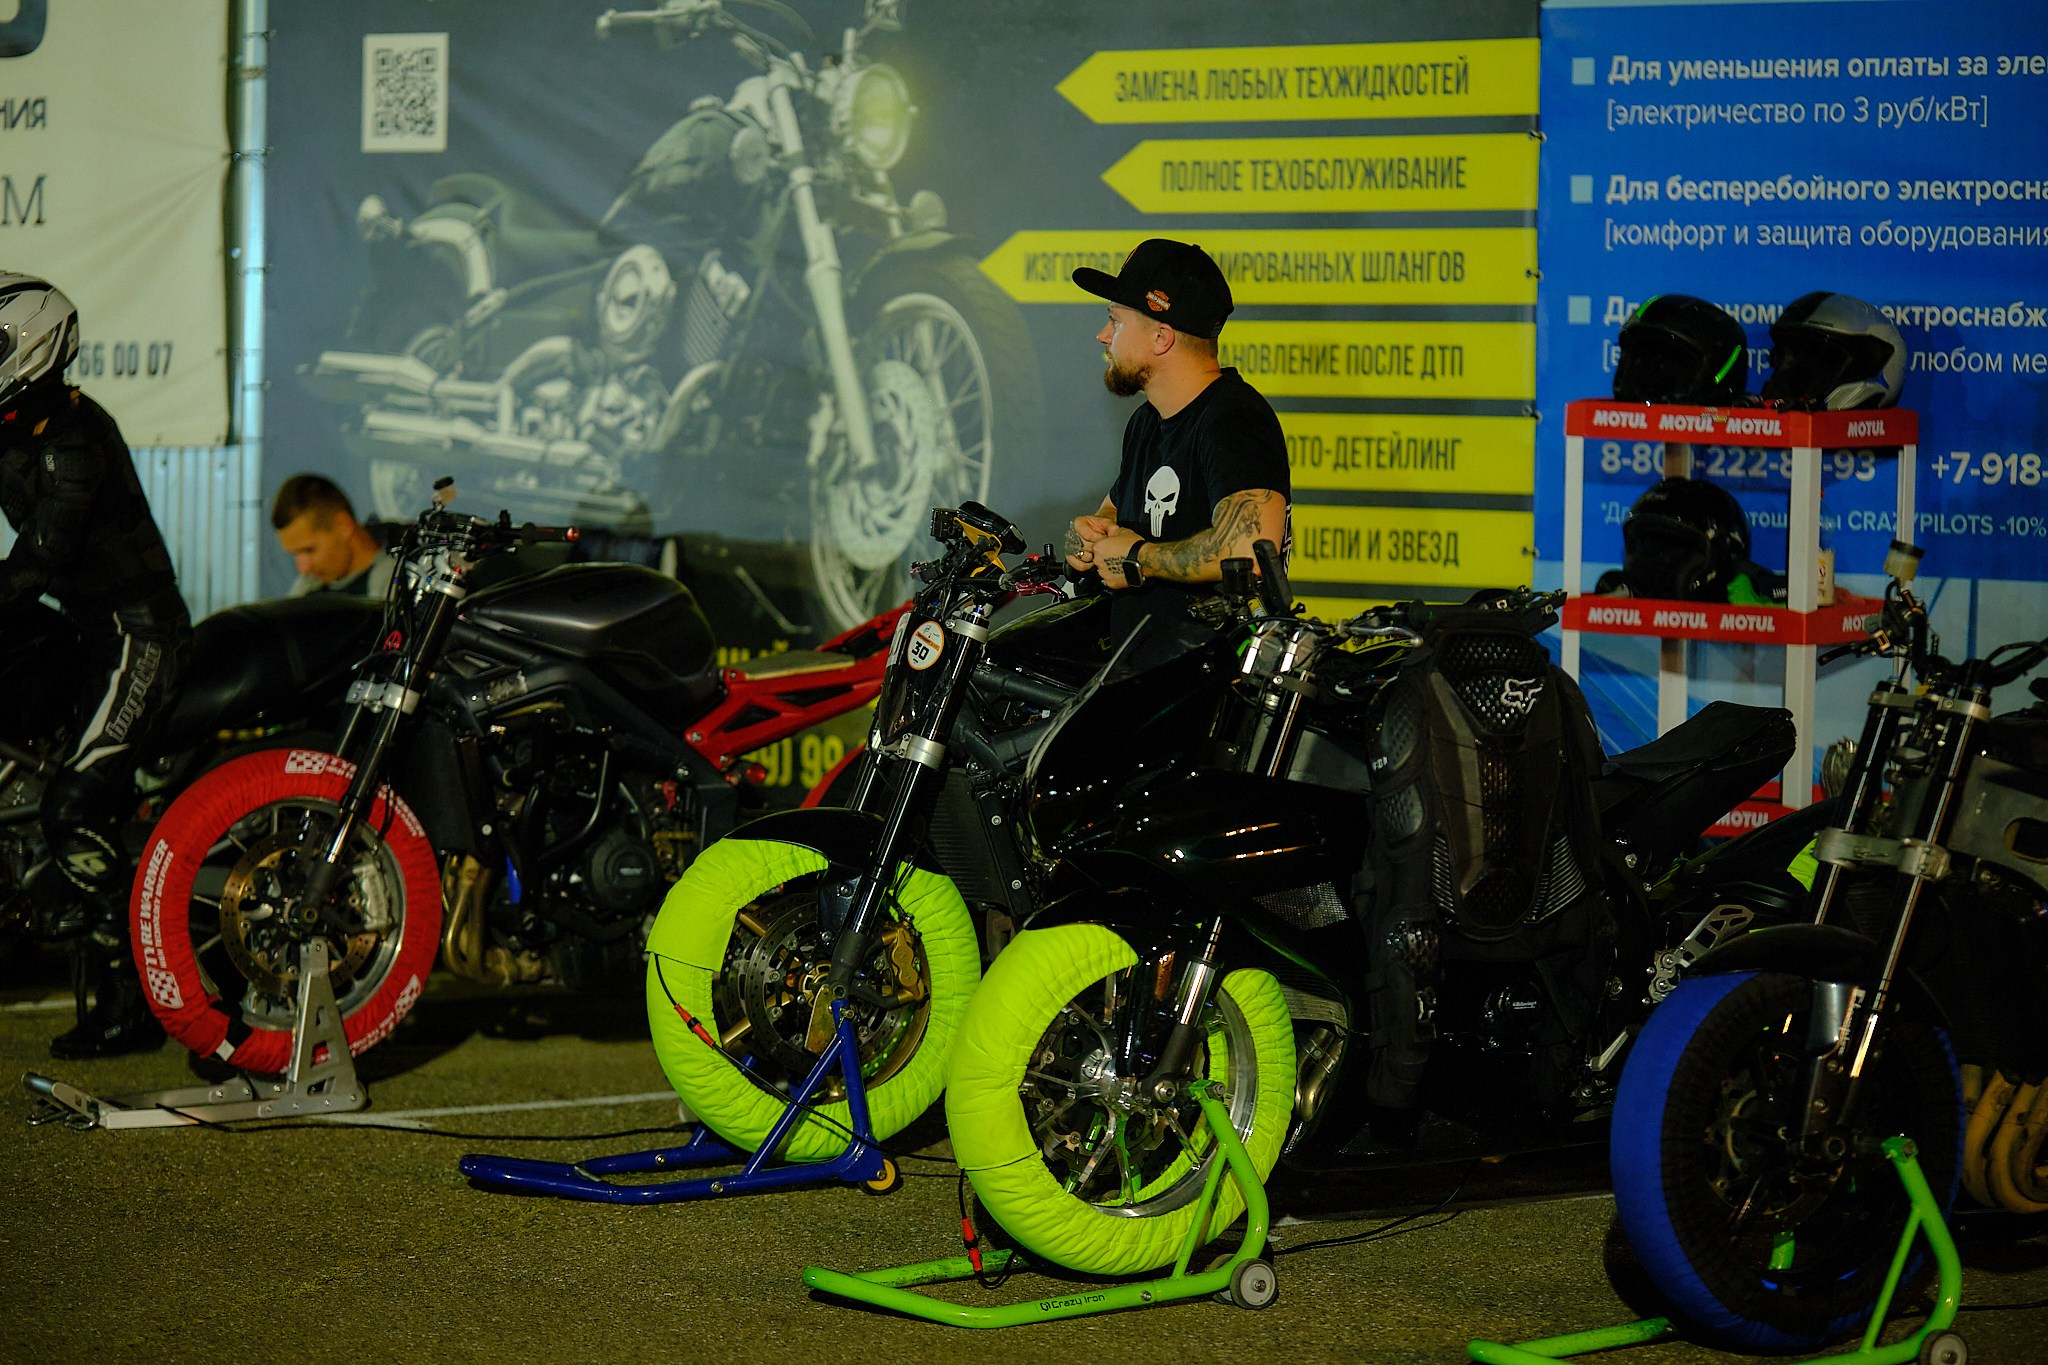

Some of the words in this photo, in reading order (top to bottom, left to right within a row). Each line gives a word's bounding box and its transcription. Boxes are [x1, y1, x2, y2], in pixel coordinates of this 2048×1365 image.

[1115, 70, 1199, 102] ЗАМЕНА
[1205, 67, 1287, 100] ЛЮБЫХ
[1295, 55, 1469, 101] ТЕХЖИДКОСТЕЙ
[1607, 55, 1659, 86] Для
[1668, 57, 1840, 87] уменьшения
[1847, 56, 1949, 78] оплаты
[1958, 56, 1988, 76] за
[1996, 54, 2048, 76] эле
[1606, 99, 1806, 132] [электричество
[1813, 102, 1845, 124] по
[1852, 97, 1869, 125] 3
[1877, 95, 1988, 130] руб/кВт]
[1161, 159, 1244, 192] ПОЛНОЕ
[1250, 156, 1468, 192] ТЕХОБСЛУЖИВАНИЕ
[1605, 175, 1659, 205] Для
[1665, 174, 1890, 208] бесперебойного
[1605, 218, 1727, 251] [комфорт
[1734, 222, 1748, 244] и
[1756, 222, 1852, 251] защита
[1362, 252, 1466, 284] ШЛАНГОВ
[113, 340, 140, 376] 00
[147, 340, 174, 376] 07
[1347, 345, 1415, 377] ПОСЛЕ
[1420, 345, 1463, 380] ДТП
[1910, 345, 2003, 374] любом
[1593, 410, 1648, 430] MOTUL
[1658, 414, 1715, 433] MOTUL
[1726, 417, 1782, 436] MOTUL
[1847, 420, 1886, 438] MOTUL
[1286, 431, 1462, 472] ОТО-ДЕТЕЙЛИНГ
[2000, 516, 2048, 538] -10%
[1304, 527, 1360, 562] ЦЕПИ
[1367, 530, 1381, 561] И
[1388, 530, 1460, 568] ЗВЕЗД
[1587, 606, 1643, 626] MOTUL
[1653, 610, 1709, 630] MOTUL
[1720, 613, 1776, 633] MOTUL
[911, 640, 930, 661] 30
[139, 838, 169, 919] WARMER
[1051, 1298, 1082, 1309] Crazy
[1084, 1294, 1106, 1304] Iron
